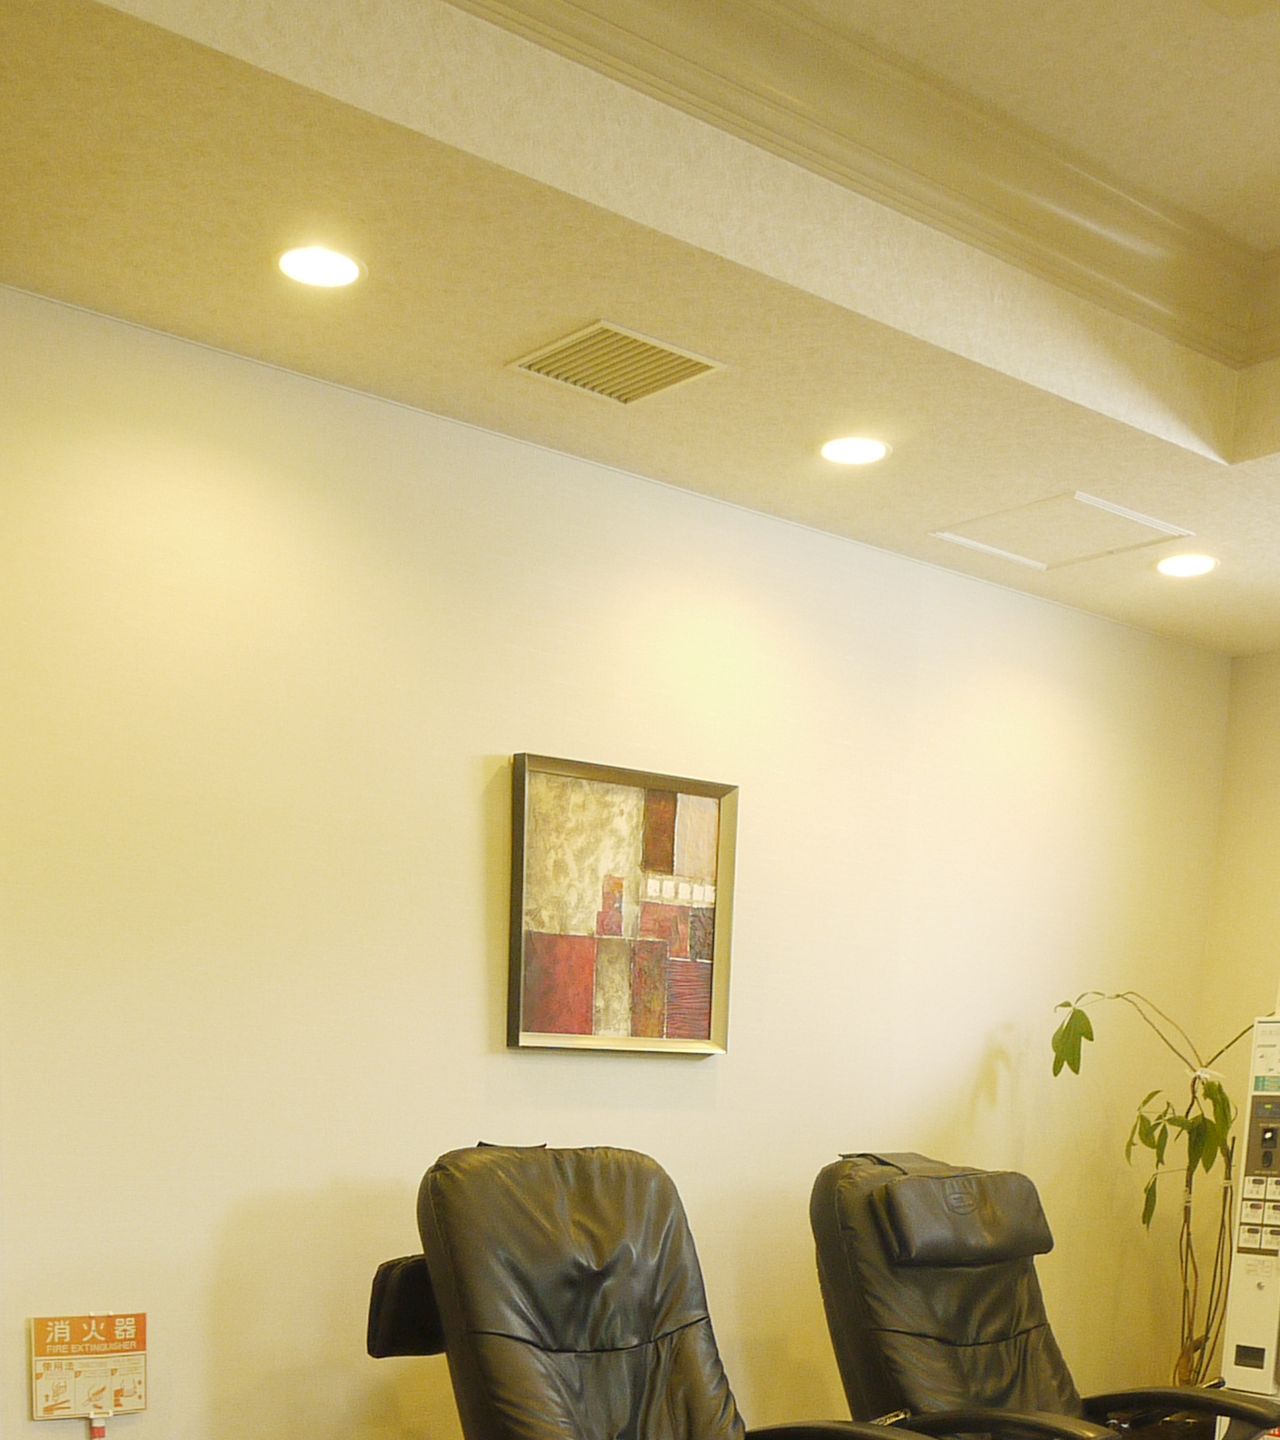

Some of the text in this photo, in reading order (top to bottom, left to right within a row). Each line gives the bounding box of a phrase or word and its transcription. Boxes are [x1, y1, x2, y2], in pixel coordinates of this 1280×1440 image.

[46, 1317, 137, 1343] 消火器
[46, 1340, 137, 1353] FIRE EXTINGUISHER
